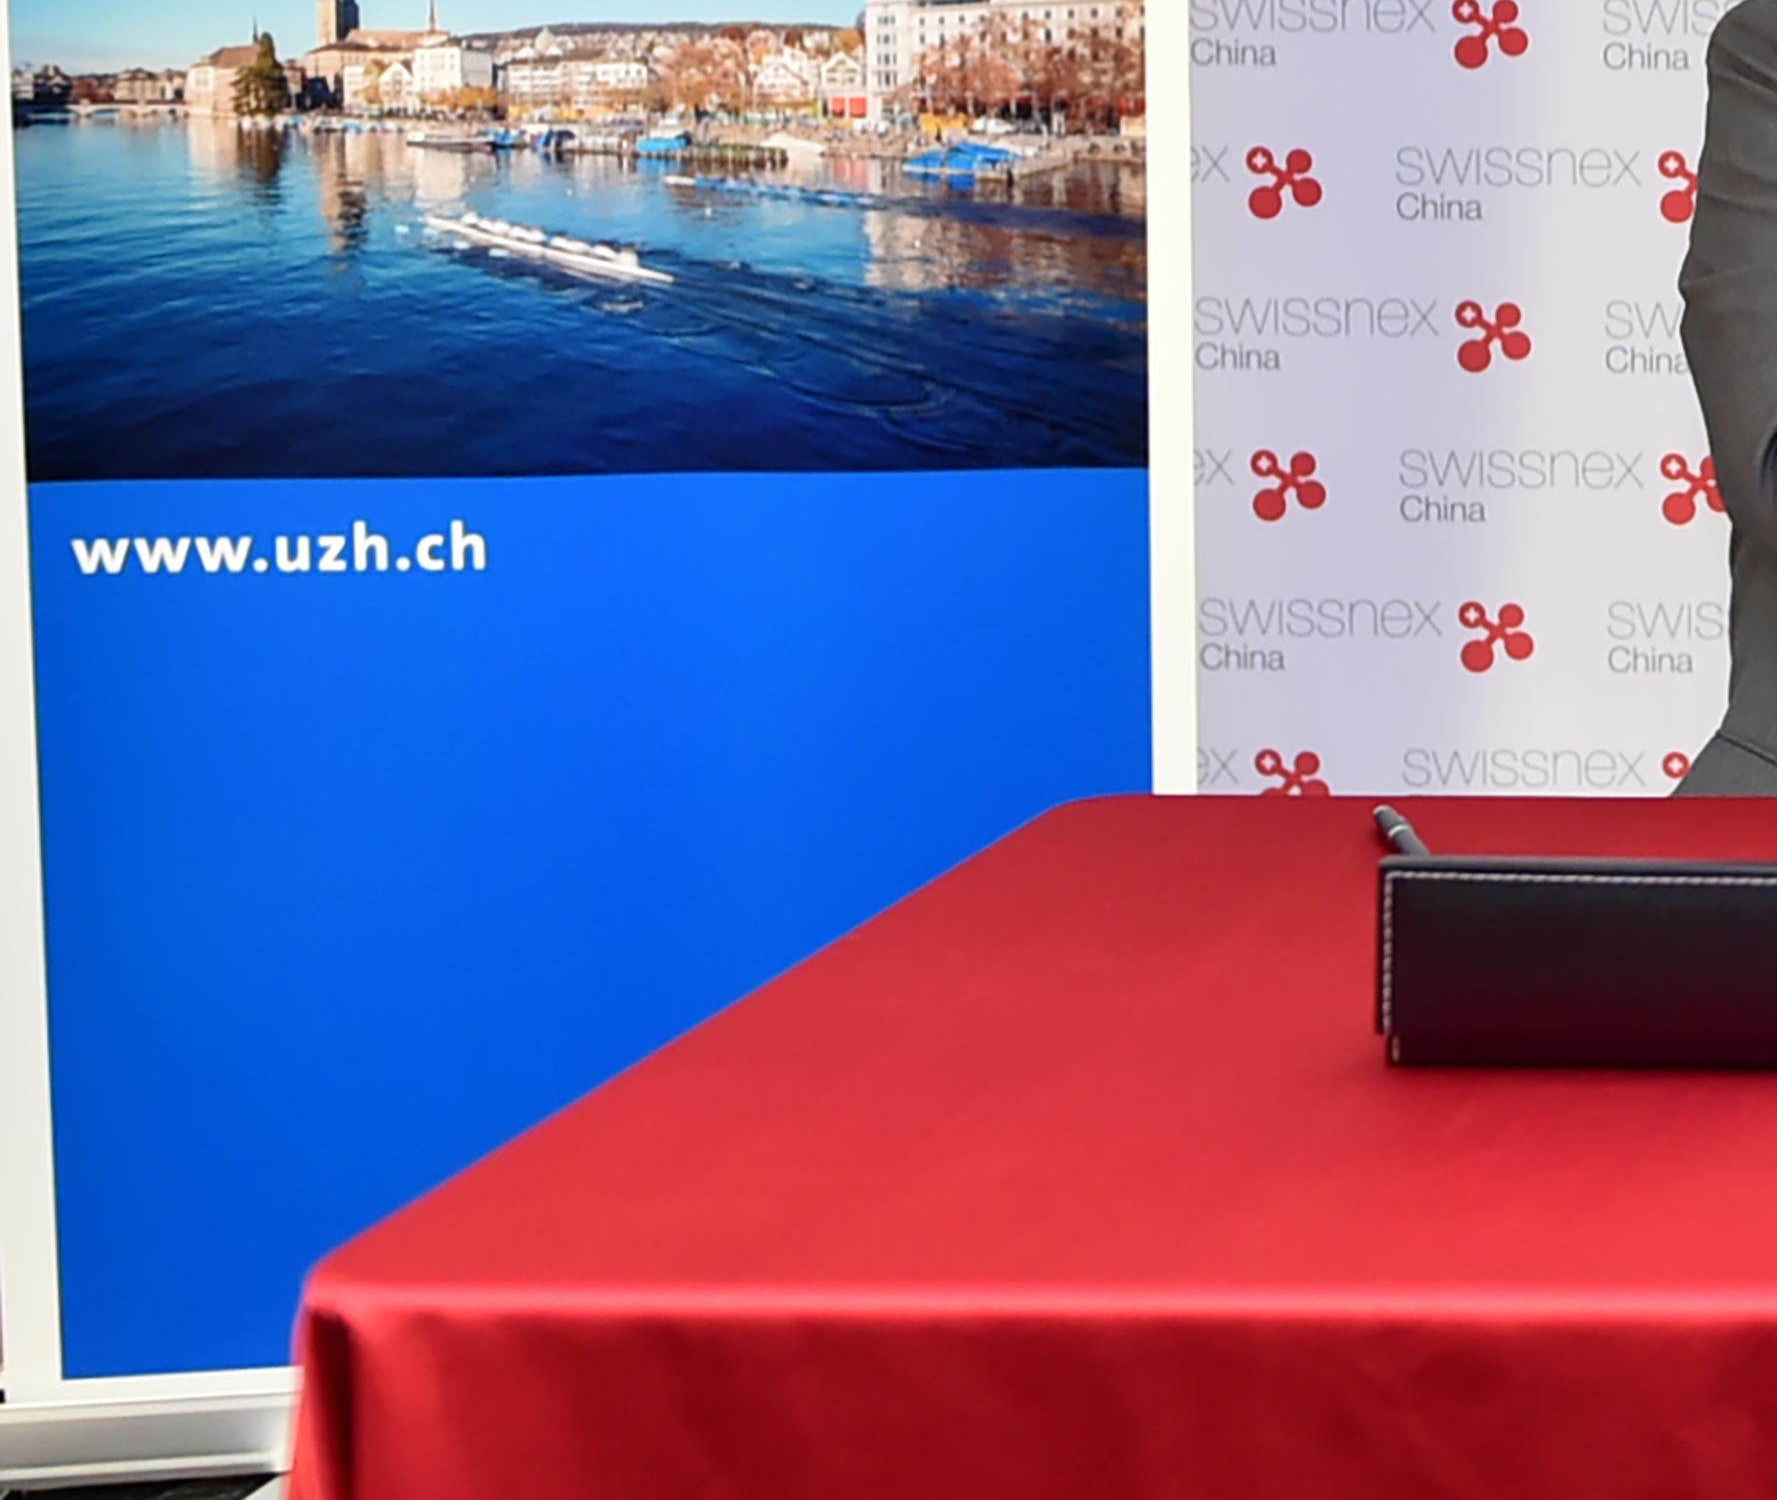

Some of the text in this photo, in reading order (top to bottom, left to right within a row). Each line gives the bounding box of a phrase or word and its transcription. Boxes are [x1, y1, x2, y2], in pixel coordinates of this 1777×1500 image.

[1186, 37, 1273, 68] China
[1603, 41, 1688, 71] China
[1396, 146, 1641, 187] swissnex
[1396, 191, 1483, 222] China
[1191, 296, 1436, 336] swissnex
[1194, 341, 1281, 371] China
[1400, 449, 1644, 488] swissnex
[1399, 493, 1486, 524] China
[71, 519, 487, 574] www.uzh.ch
[1197, 598, 1440, 637] swissnex
[1198, 642, 1285, 672] China
[1608, 645, 1694, 674] China
[1405, 748, 1647, 786] swissnex
